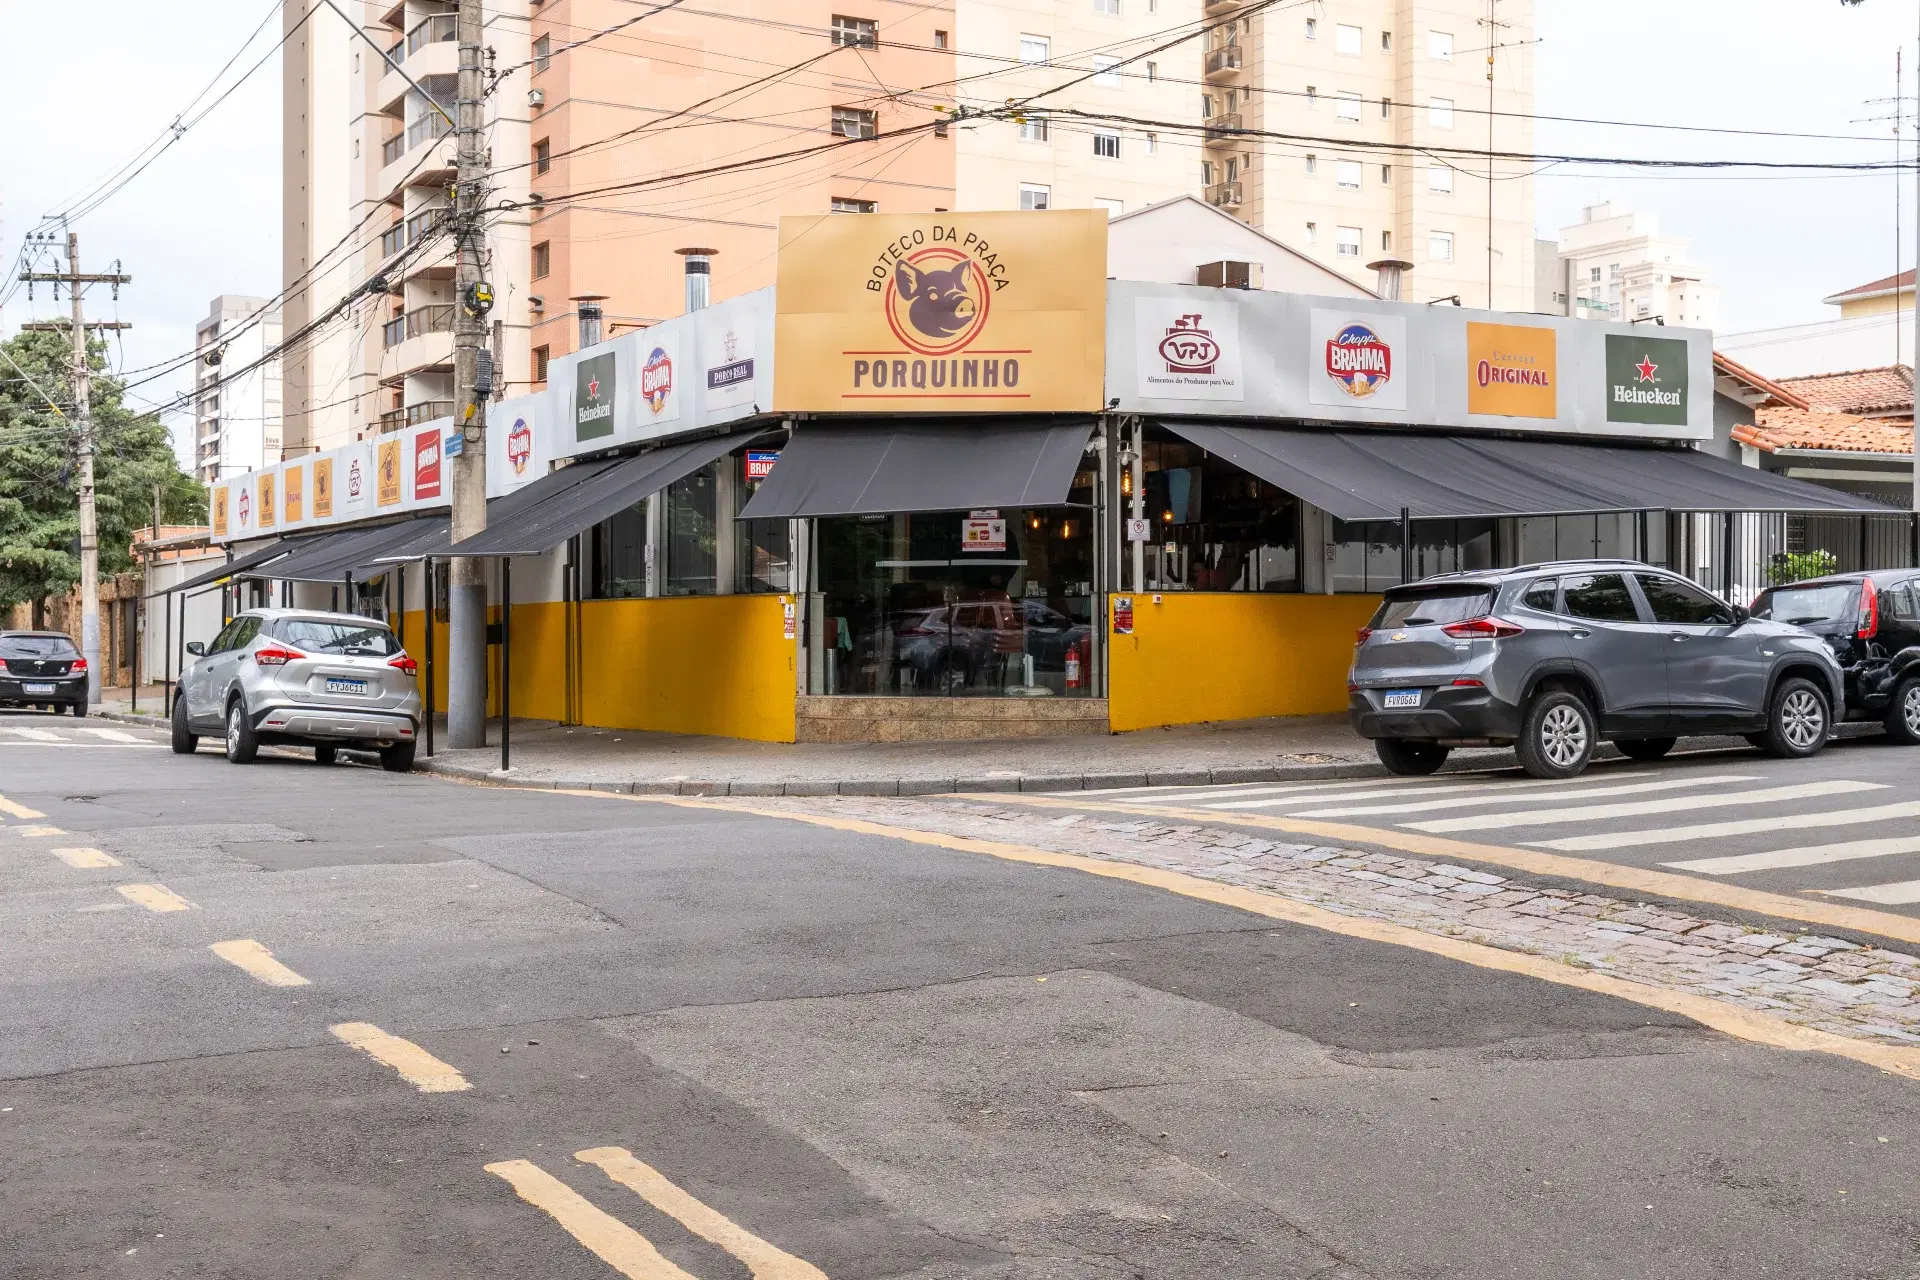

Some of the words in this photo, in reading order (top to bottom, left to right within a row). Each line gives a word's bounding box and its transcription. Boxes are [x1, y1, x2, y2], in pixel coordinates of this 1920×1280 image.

[866, 229, 925, 292] BOTECO
[933, 226, 957, 242] DA
[963, 232, 1010, 292] PRAÇA
[1167, 341, 1211, 360] VPJ
[1338, 333, 1377, 347] Chopp
[1331, 345, 1387, 373] BRAHMA
[1493, 351, 1536, 364] Cerveja
[644, 365, 669, 393] BRAHMA
[714, 369, 732, 384] PORCO
[733, 364, 748, 379] REAL
[854, 358, 1019, 390] PORQUINHO
[1147, 376, 1174, 384] Alimentos
[1184, 377, 1208, 385] Produtor
[1209, 379, 1221, 387] para
[1221, 378, 1235, 386] Você
[1477, 359, 1549, 387] ORIGINAL
[1613, 385, 1681, 406] Heineken
[579, 402, 610, 423] Heineken
[330, 682, 364, 693] FYJ6C11
